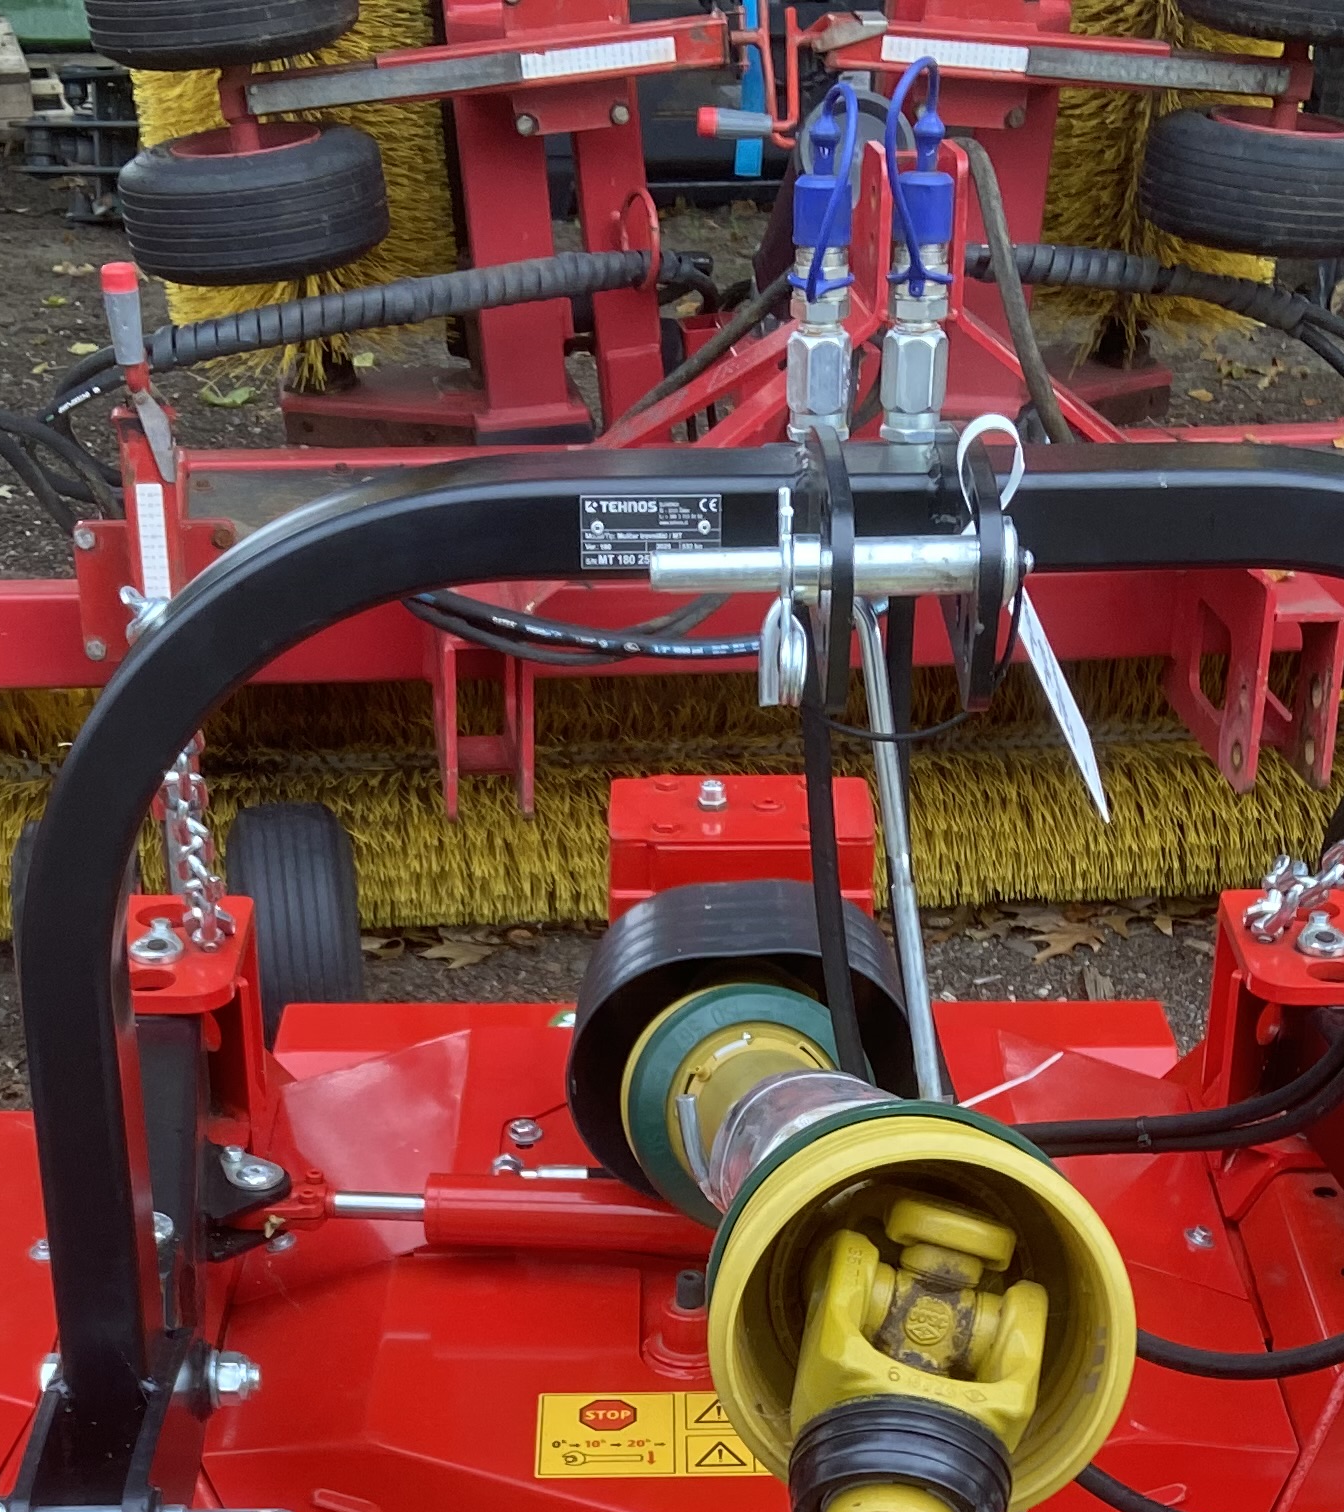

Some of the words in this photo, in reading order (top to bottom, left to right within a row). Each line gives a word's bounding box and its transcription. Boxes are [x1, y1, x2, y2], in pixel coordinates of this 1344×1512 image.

[600, 500, 658, 513] TEHNOS
[699, 498, 718, 512] CE
[598, 554, 615, 565] MT
[617, 554, 636, 565] 180
[585, 1409, 631, 1420] STOP
